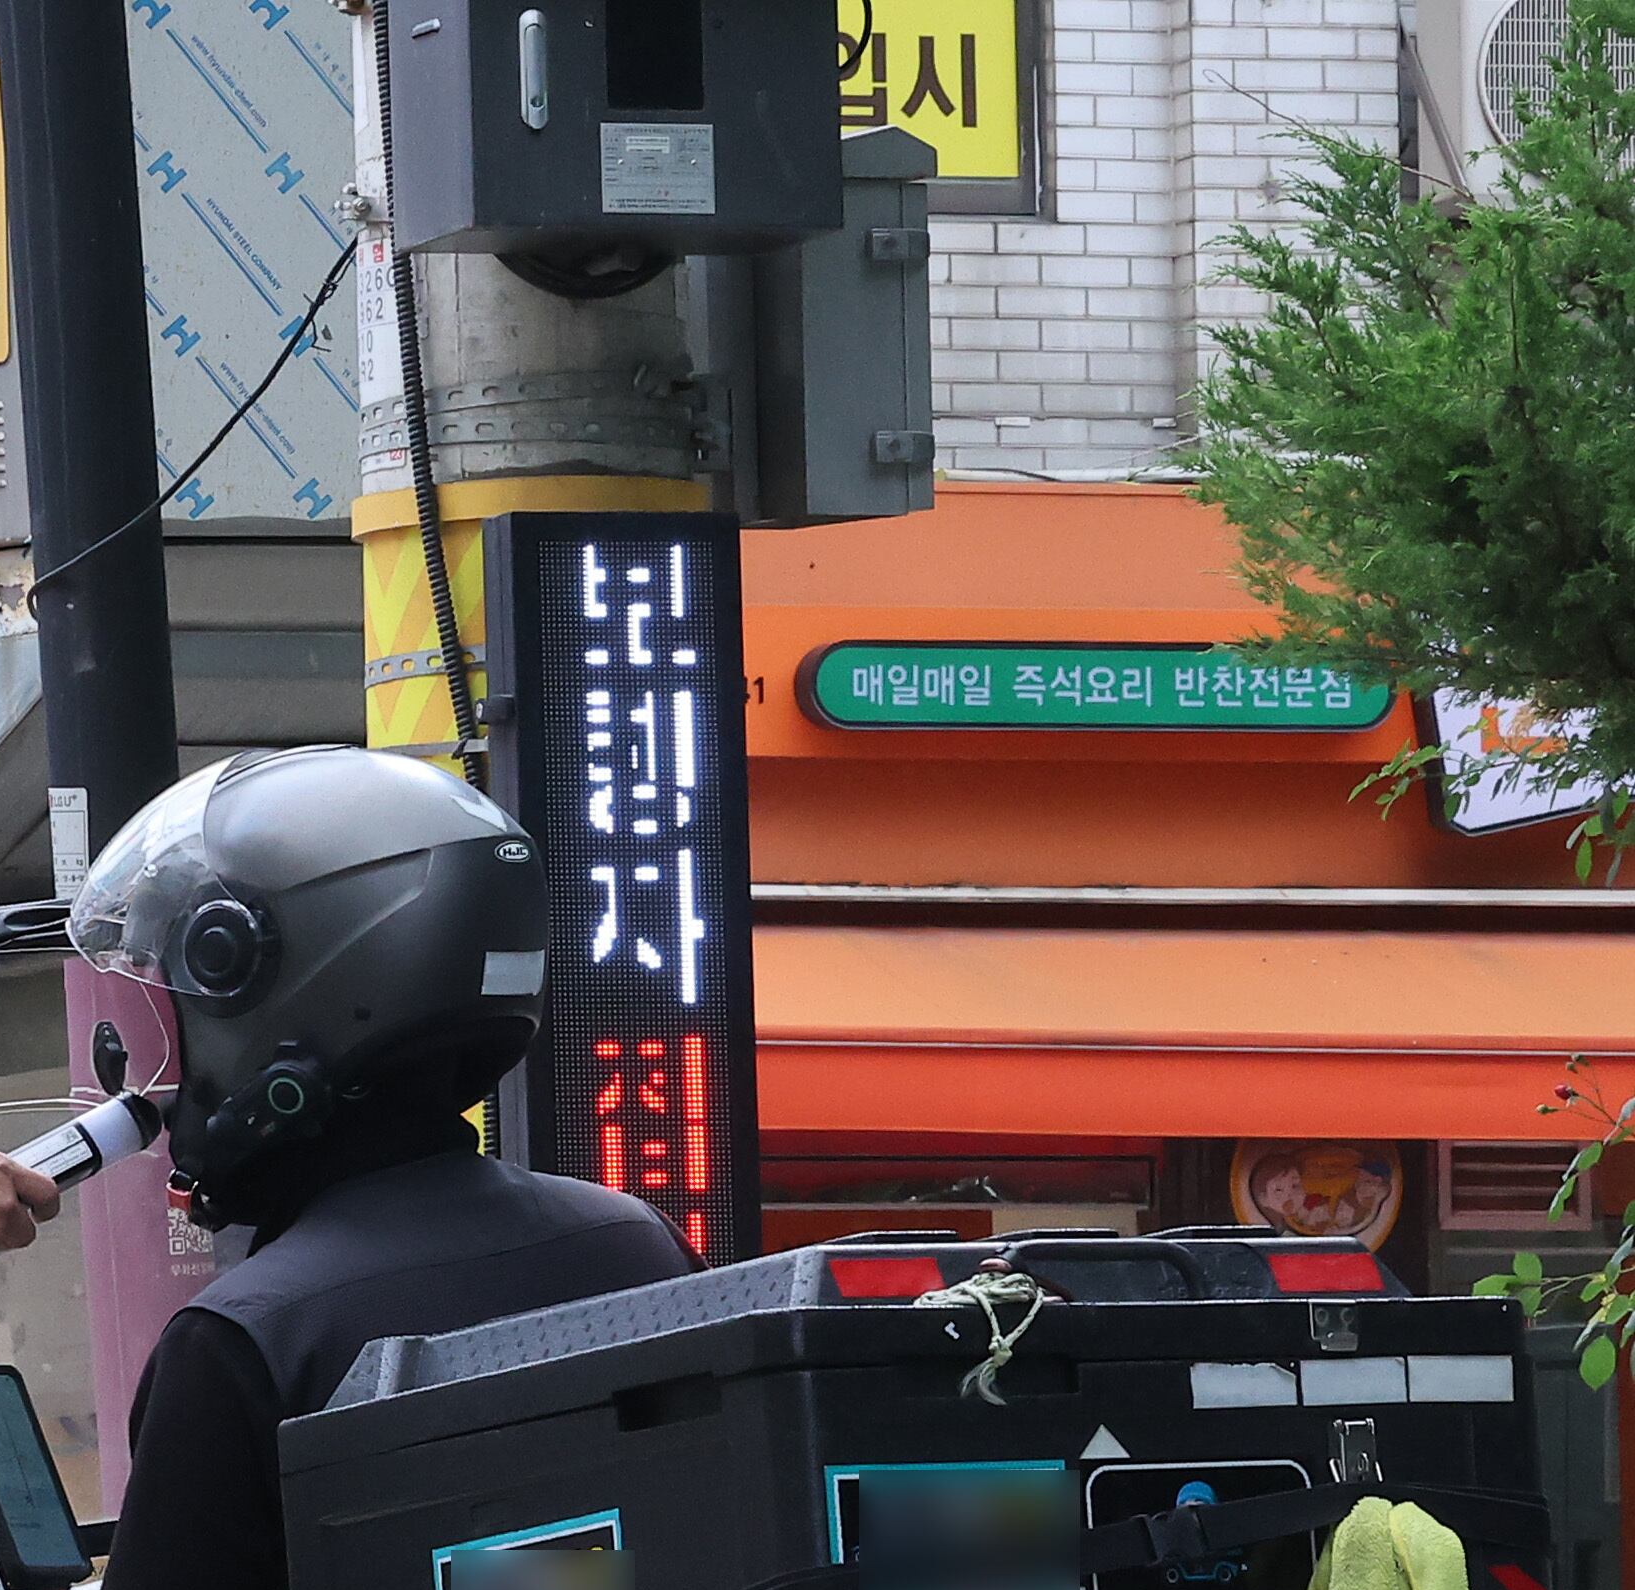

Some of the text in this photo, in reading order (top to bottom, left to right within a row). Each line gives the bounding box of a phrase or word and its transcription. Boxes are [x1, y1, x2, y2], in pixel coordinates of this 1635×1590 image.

[230, 229, 255, 256] STEEL
[852, 663, 1353, 709] 매일매일 즉석요리 반찬전문점
